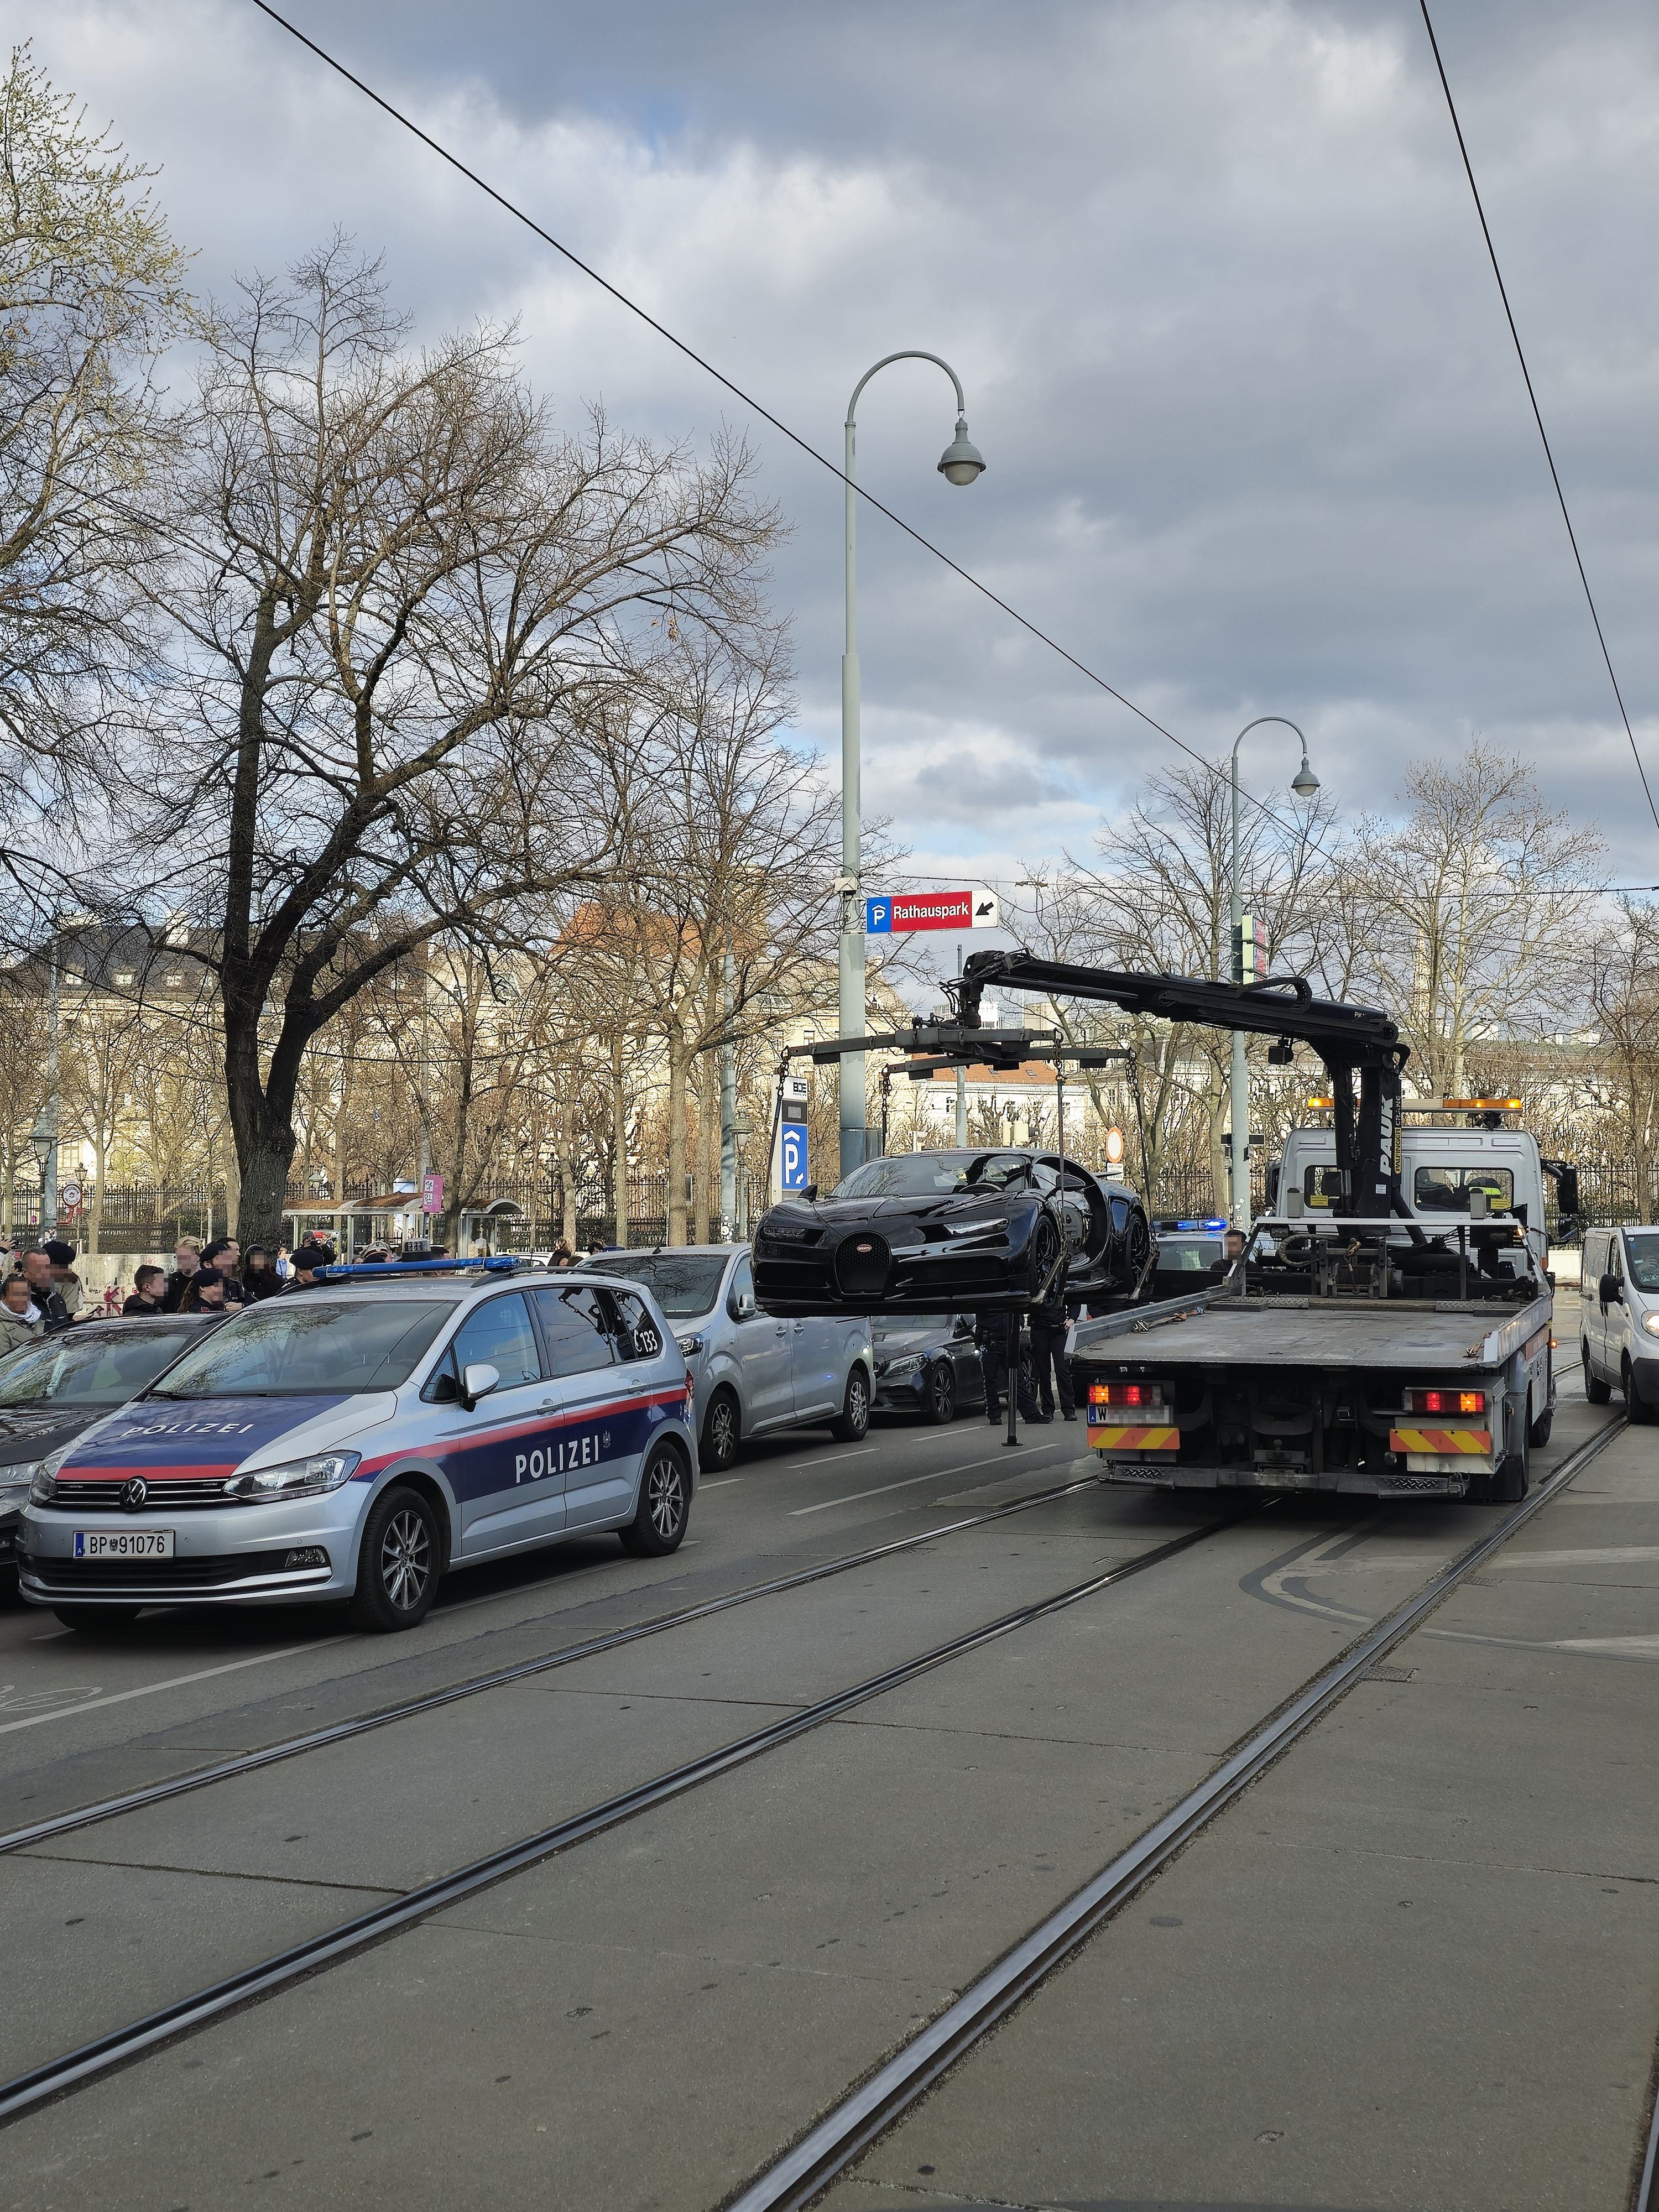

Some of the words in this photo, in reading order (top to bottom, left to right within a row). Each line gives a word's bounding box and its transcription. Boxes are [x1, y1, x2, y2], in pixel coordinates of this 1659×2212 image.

[874, 910, 885, 925] P
[894, 901, 969, 920] Rathauspark
[1380, 1094, 1393, 1177] PAUK
[785, 1143, 799, 1184] P
[639, 1329, 658, 1353] 133
[120, 1423, 255, 1438] POLIZEI
[515, 1434, 599, 1484] POLIZEI
[90, 1536, 107, 1554] BP
[118, 1535, 165, 1554] 91076
